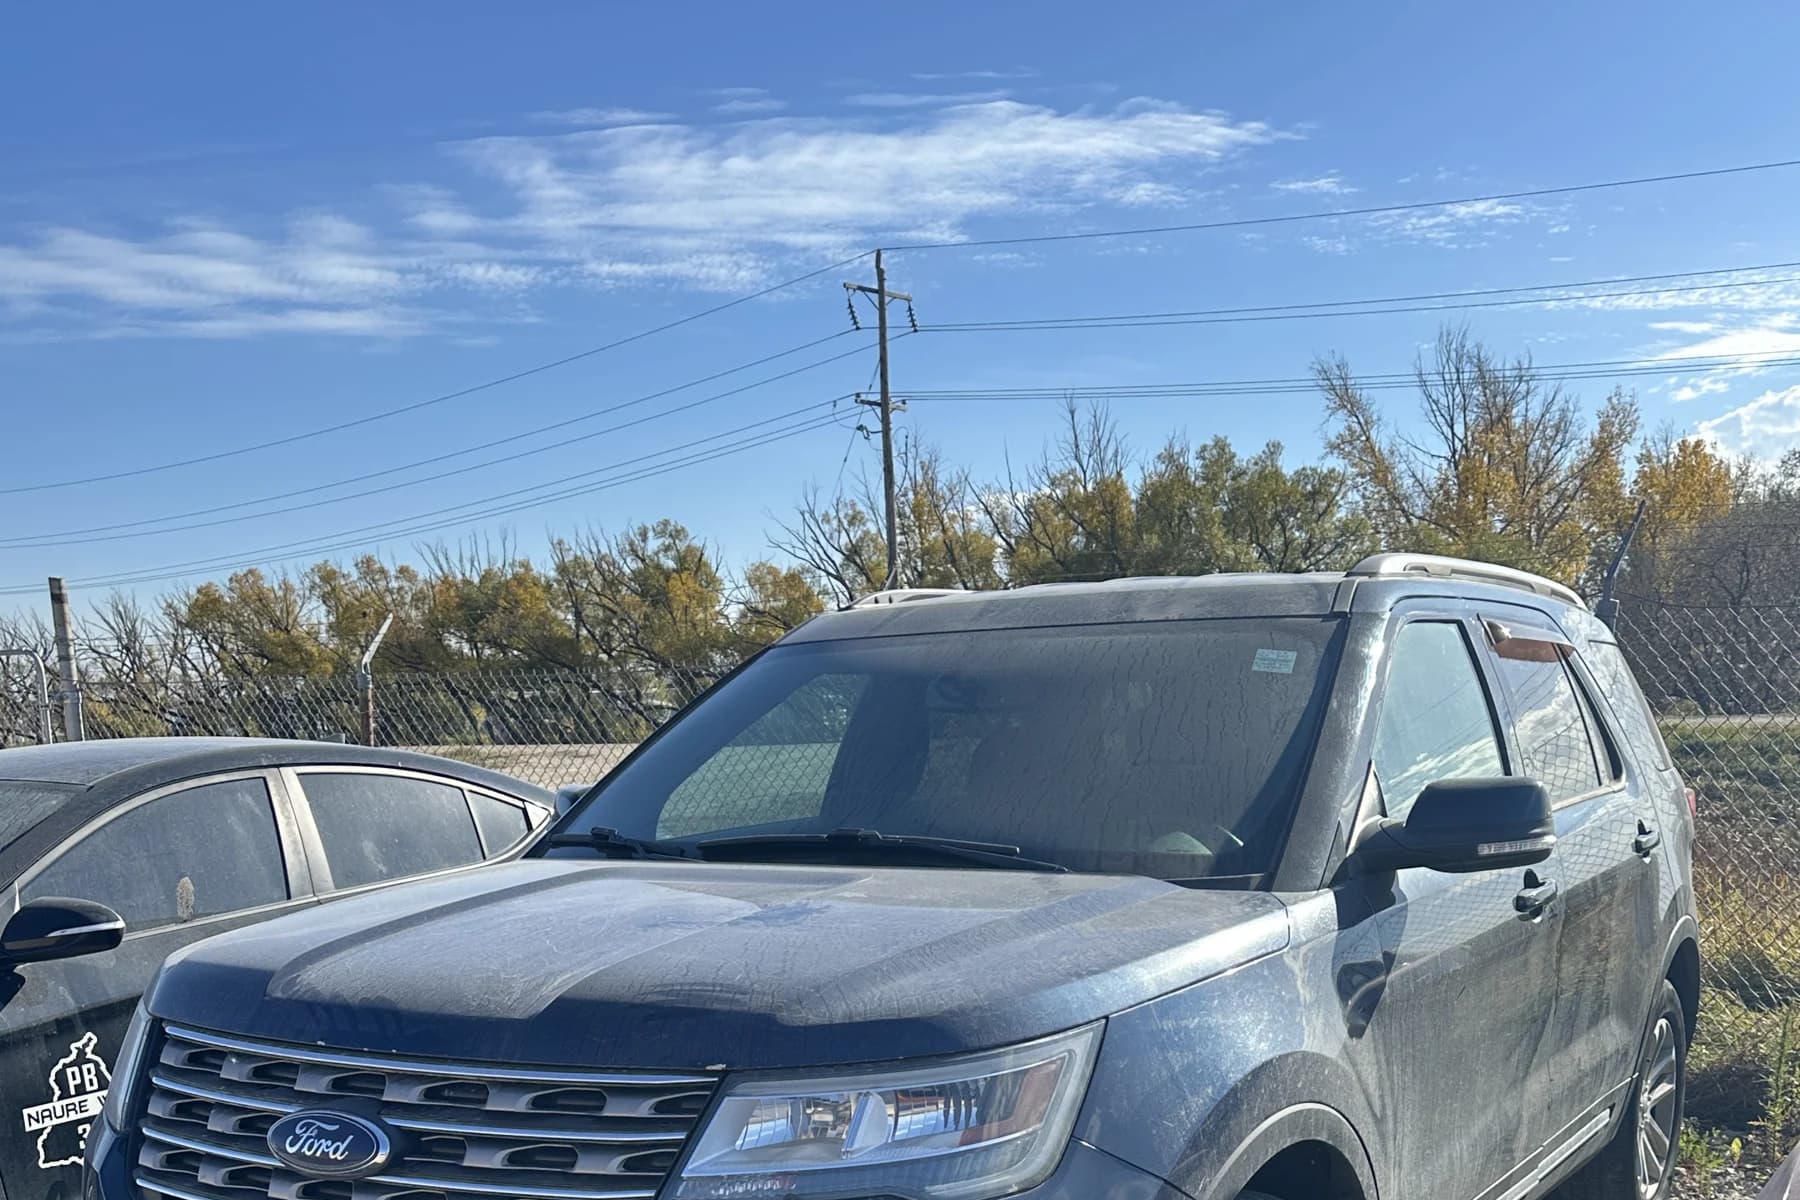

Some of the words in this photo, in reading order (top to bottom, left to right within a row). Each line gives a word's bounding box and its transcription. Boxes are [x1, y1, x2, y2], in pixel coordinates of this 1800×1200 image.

[66, 1062, 99, 1096] PB
[27, 1099, 90, 1127] NAURE
[285, 1119, 354, 1161] Ford
